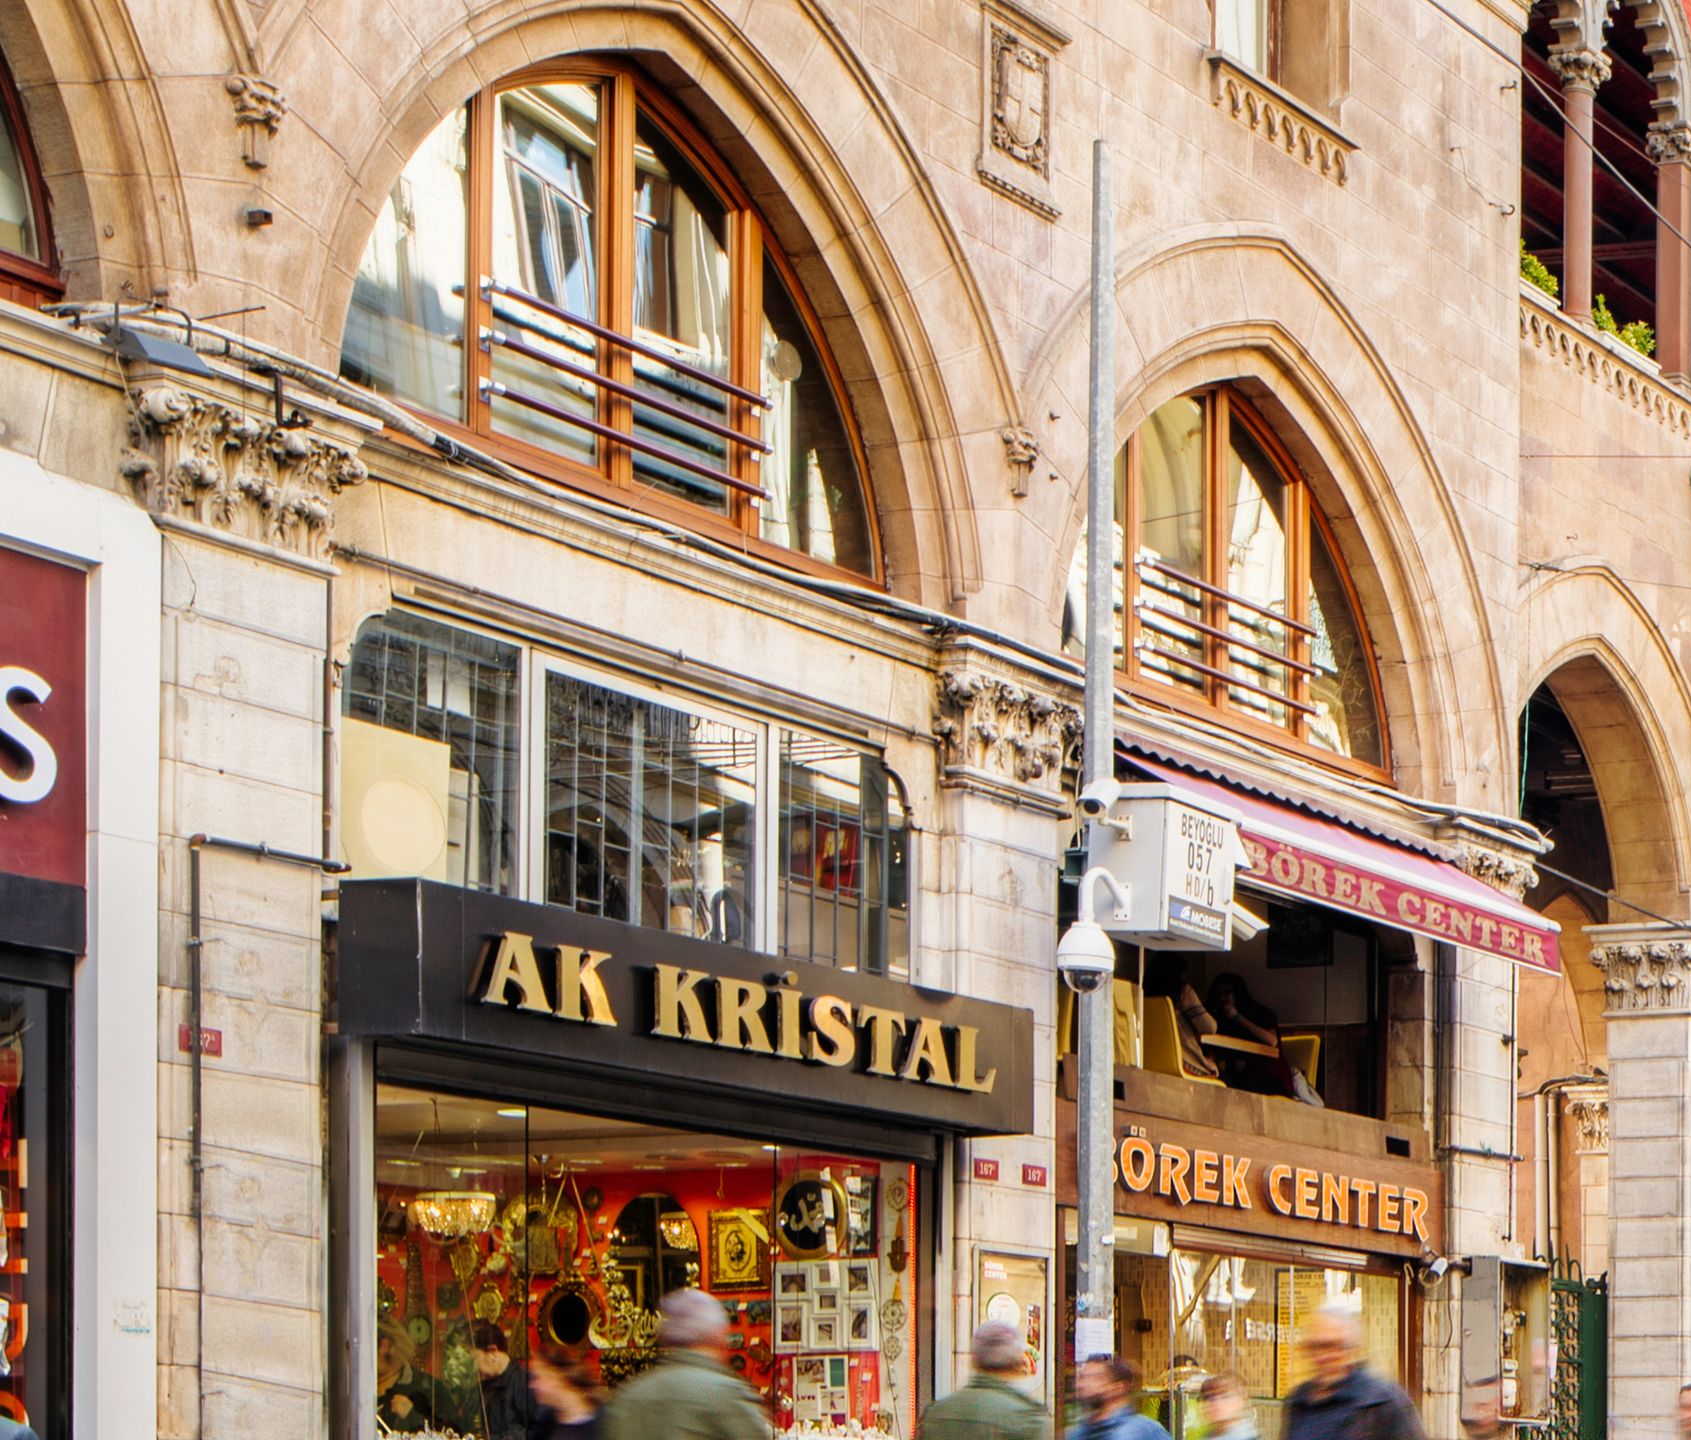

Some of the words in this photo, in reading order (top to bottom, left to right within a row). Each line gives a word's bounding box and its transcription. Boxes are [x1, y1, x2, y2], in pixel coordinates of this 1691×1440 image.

[1181, 813, 1224, 849] BEYOĞLU
[1187, 841, 1213, 875] 057
[1243, 838, 1388, 915] BÖREK
[1397, 891, 1548, 965] CENTER
[481, 931, 618, 1027] AK
[650, 962, 997, 1094] KRİSTAL
[1266, 1164, 1429, 1243] CENTER
